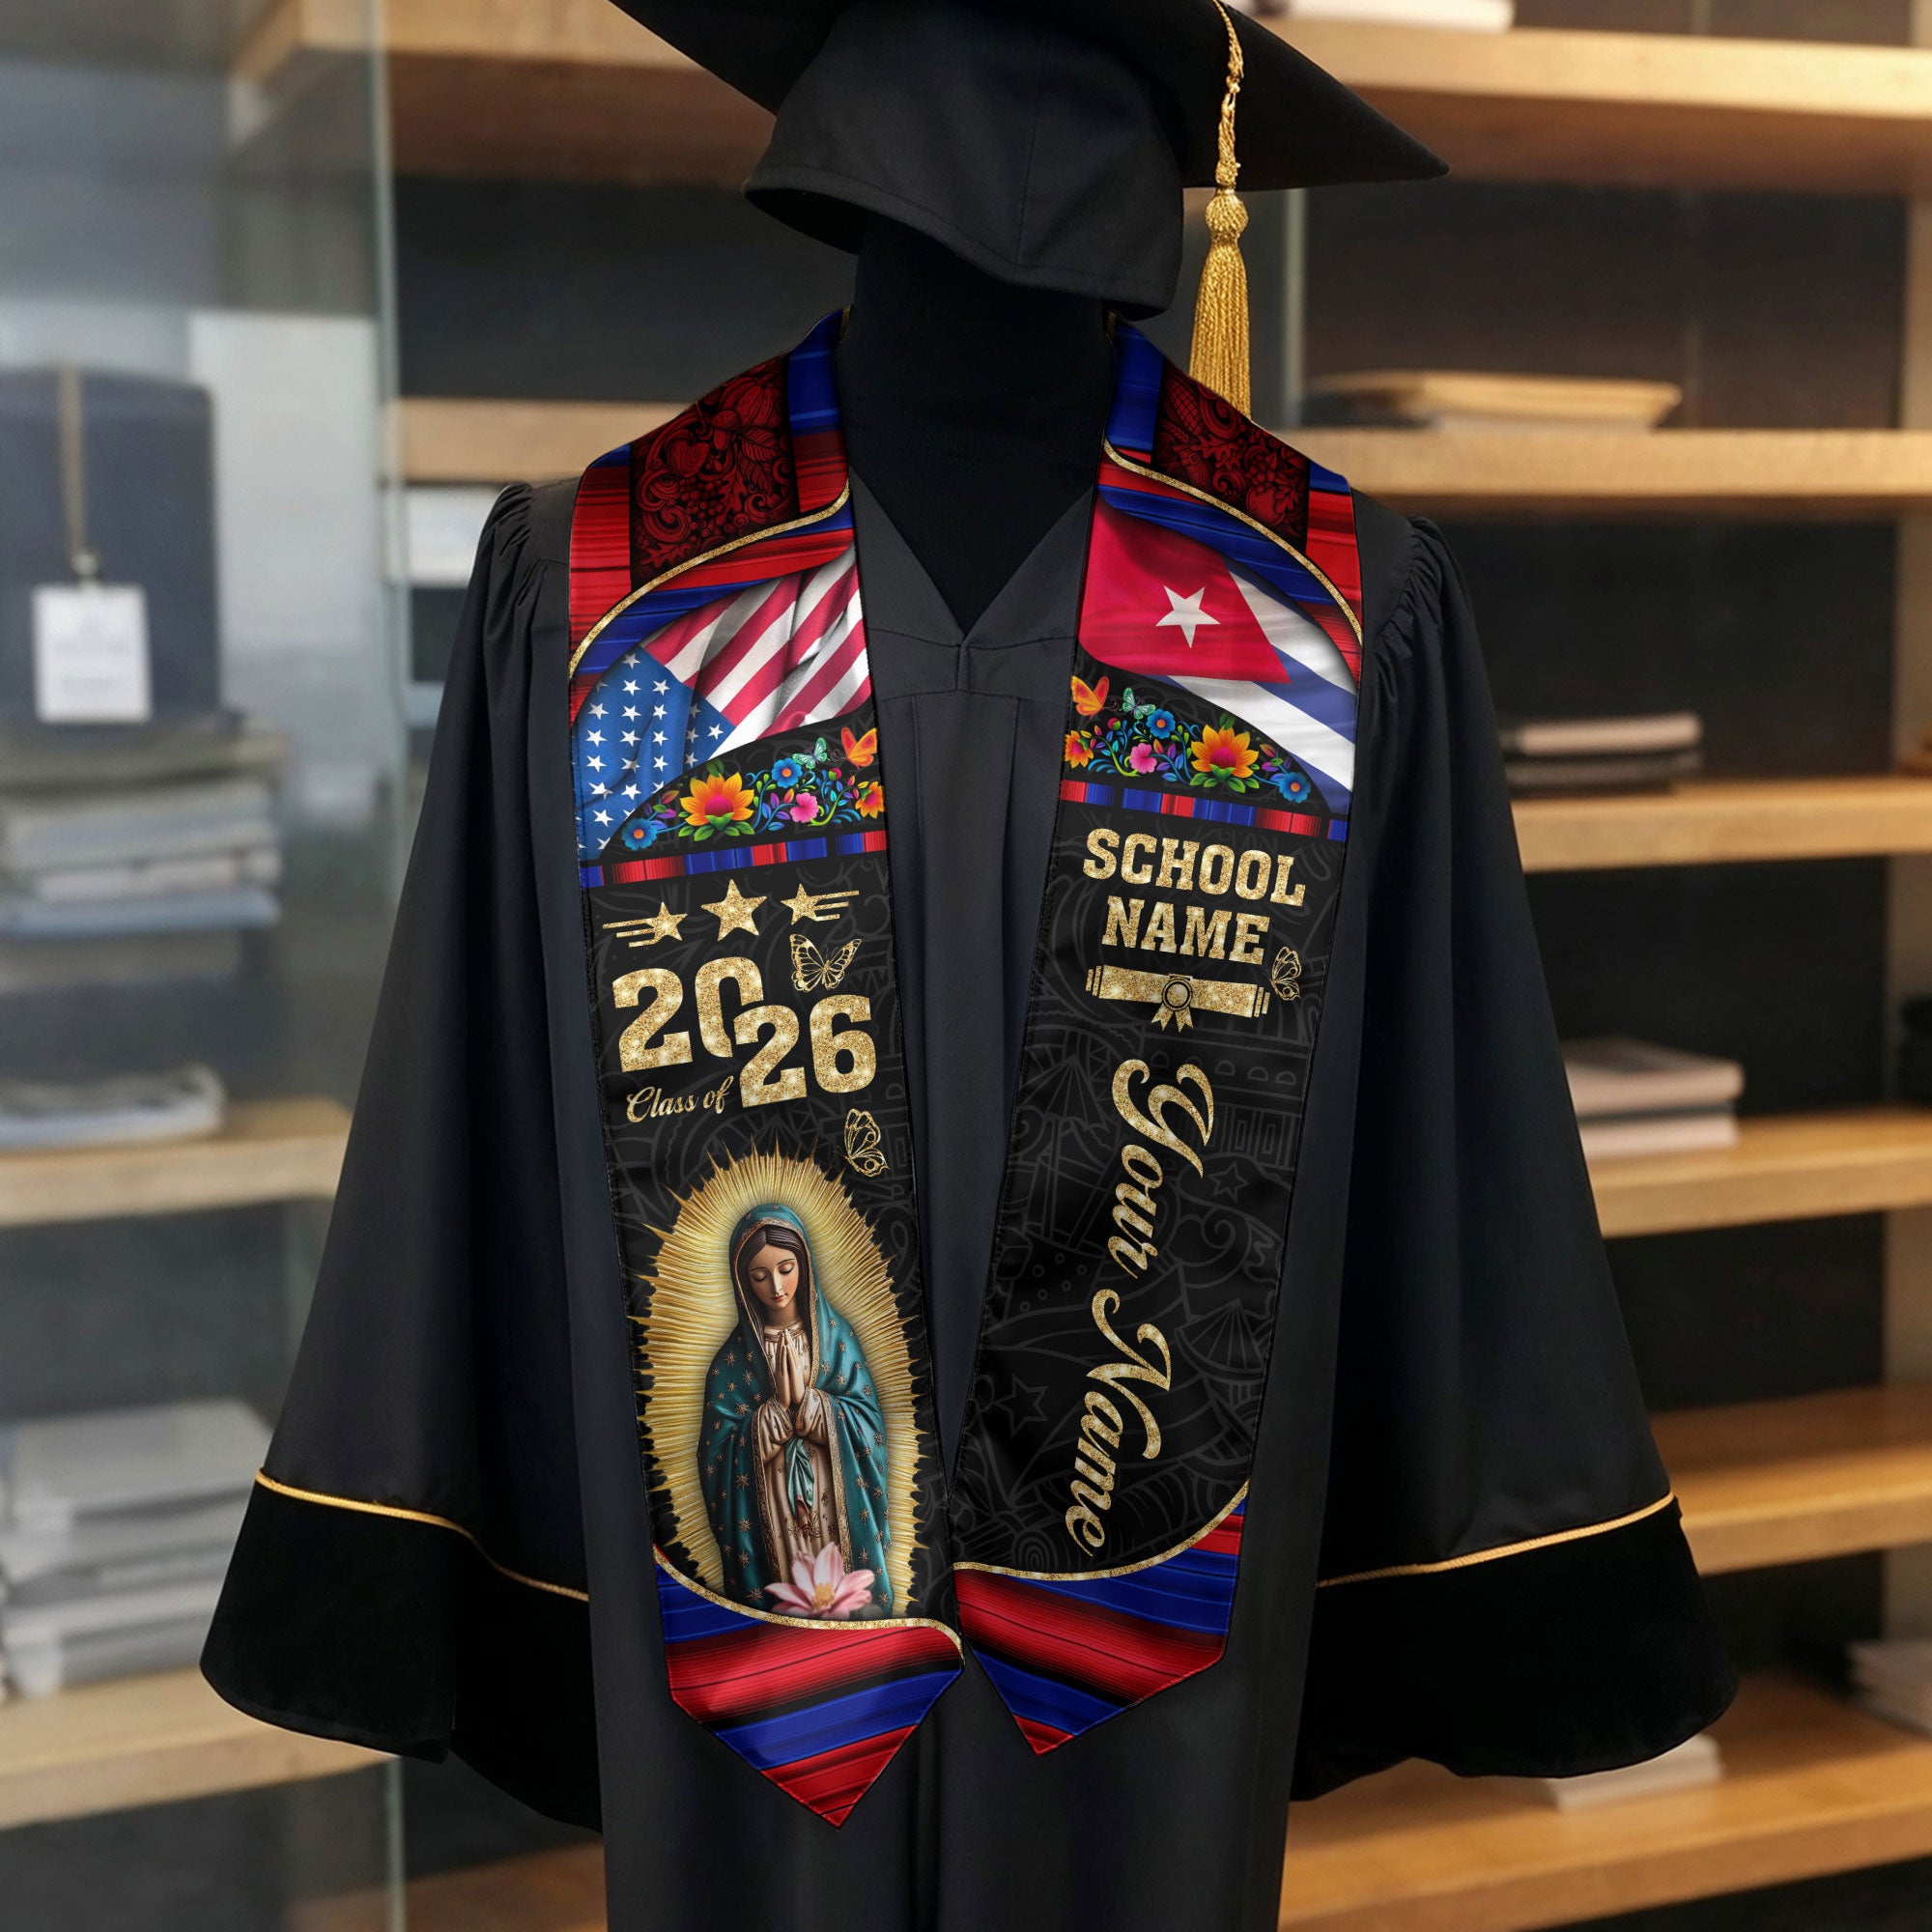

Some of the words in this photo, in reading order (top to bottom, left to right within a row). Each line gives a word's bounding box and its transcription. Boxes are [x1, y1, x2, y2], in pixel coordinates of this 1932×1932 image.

[1082, 827, 1306, 907] SCHOOL
[1101, 895, 1271, 966] NAME
[626, 1086, 697, 1123] Class
[702, 1074, 734, 1115] of
[1107, 1059, 1214, 1280] Your
[1065, 1289, 1172, 1558] Name
